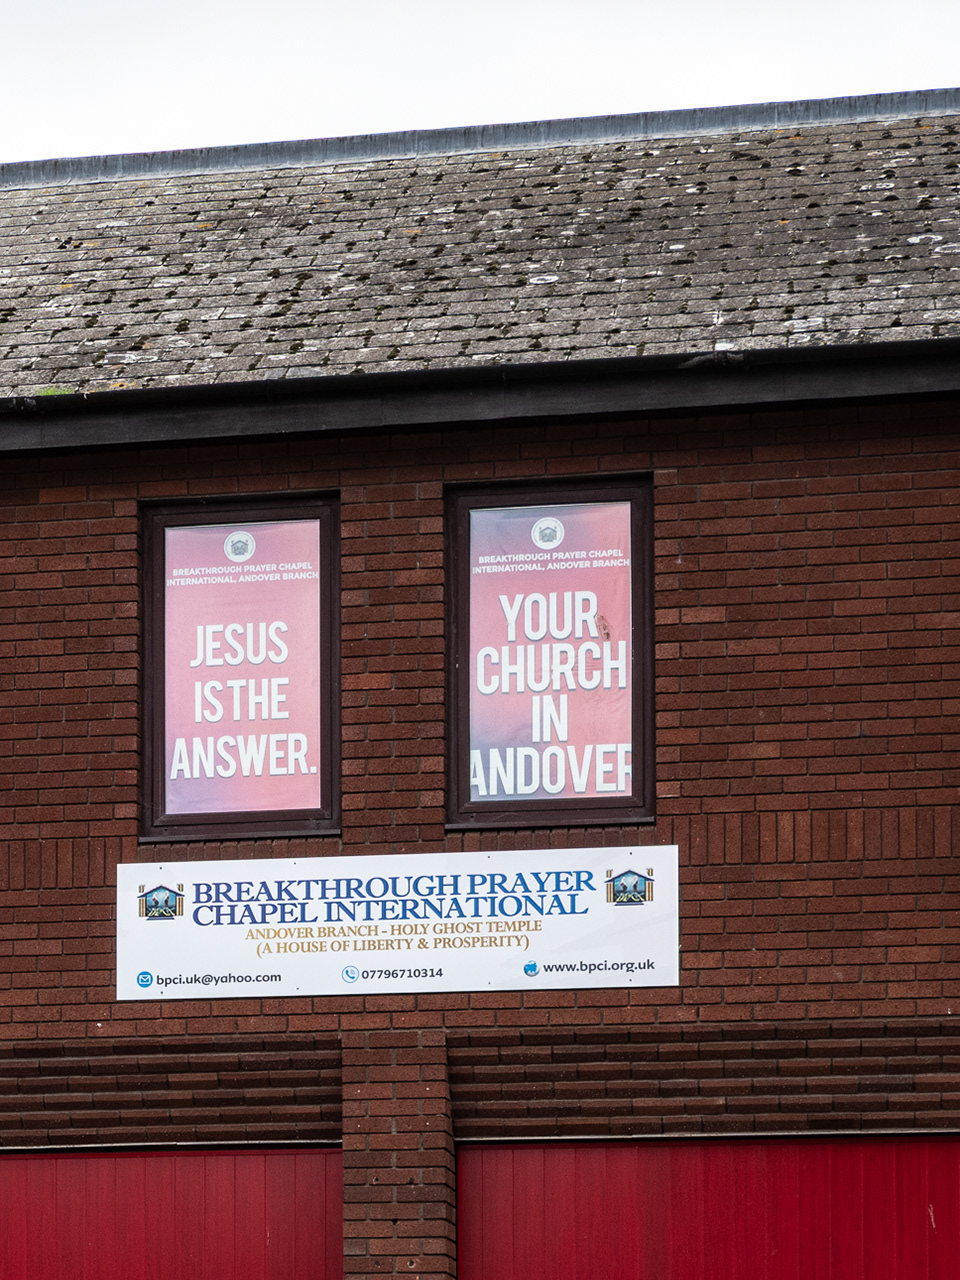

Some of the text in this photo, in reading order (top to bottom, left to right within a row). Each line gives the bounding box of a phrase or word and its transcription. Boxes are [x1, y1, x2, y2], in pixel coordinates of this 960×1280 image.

[166, 571, 319, 587] INTERNATIONAL, ANDOVER BRANCH
[172, 562, 312, 577] BREAKTHROUGH PRAYER CHAPEL
[499, 591, 599, 642] YOUR
[190, 621, 289, 668] JESUS
[476, 640, 627, 694] CHURCH
[194, 677, 289, 723] IS THE
[531, 694, 568, 743] IN
[170, 732, 318, 780] ANSWER.
[192, 871, 597, 904] BREAKTHROUGH PRAYER
[192, 894, 589, 926] CHAPEL INTERNATIONAL
[245, 927, 314, 940] ANDOVER
[317, 925, 379, 938] BRANCH
[390, 923, 430, 936] HOLY
[432, 921, 483, 935] GHOST
[485, 919, 542, 933] TEMPLE
[256, 934, 530, 959] (A HOUSE OF LIBERTY & PROSPERITY)
[156, 972, 282, 988] bpci.uk@yahoo.com
[362, 968, 443, 980] 07796710314
[543, 959, 655, 974] www.bpci.org.uk
